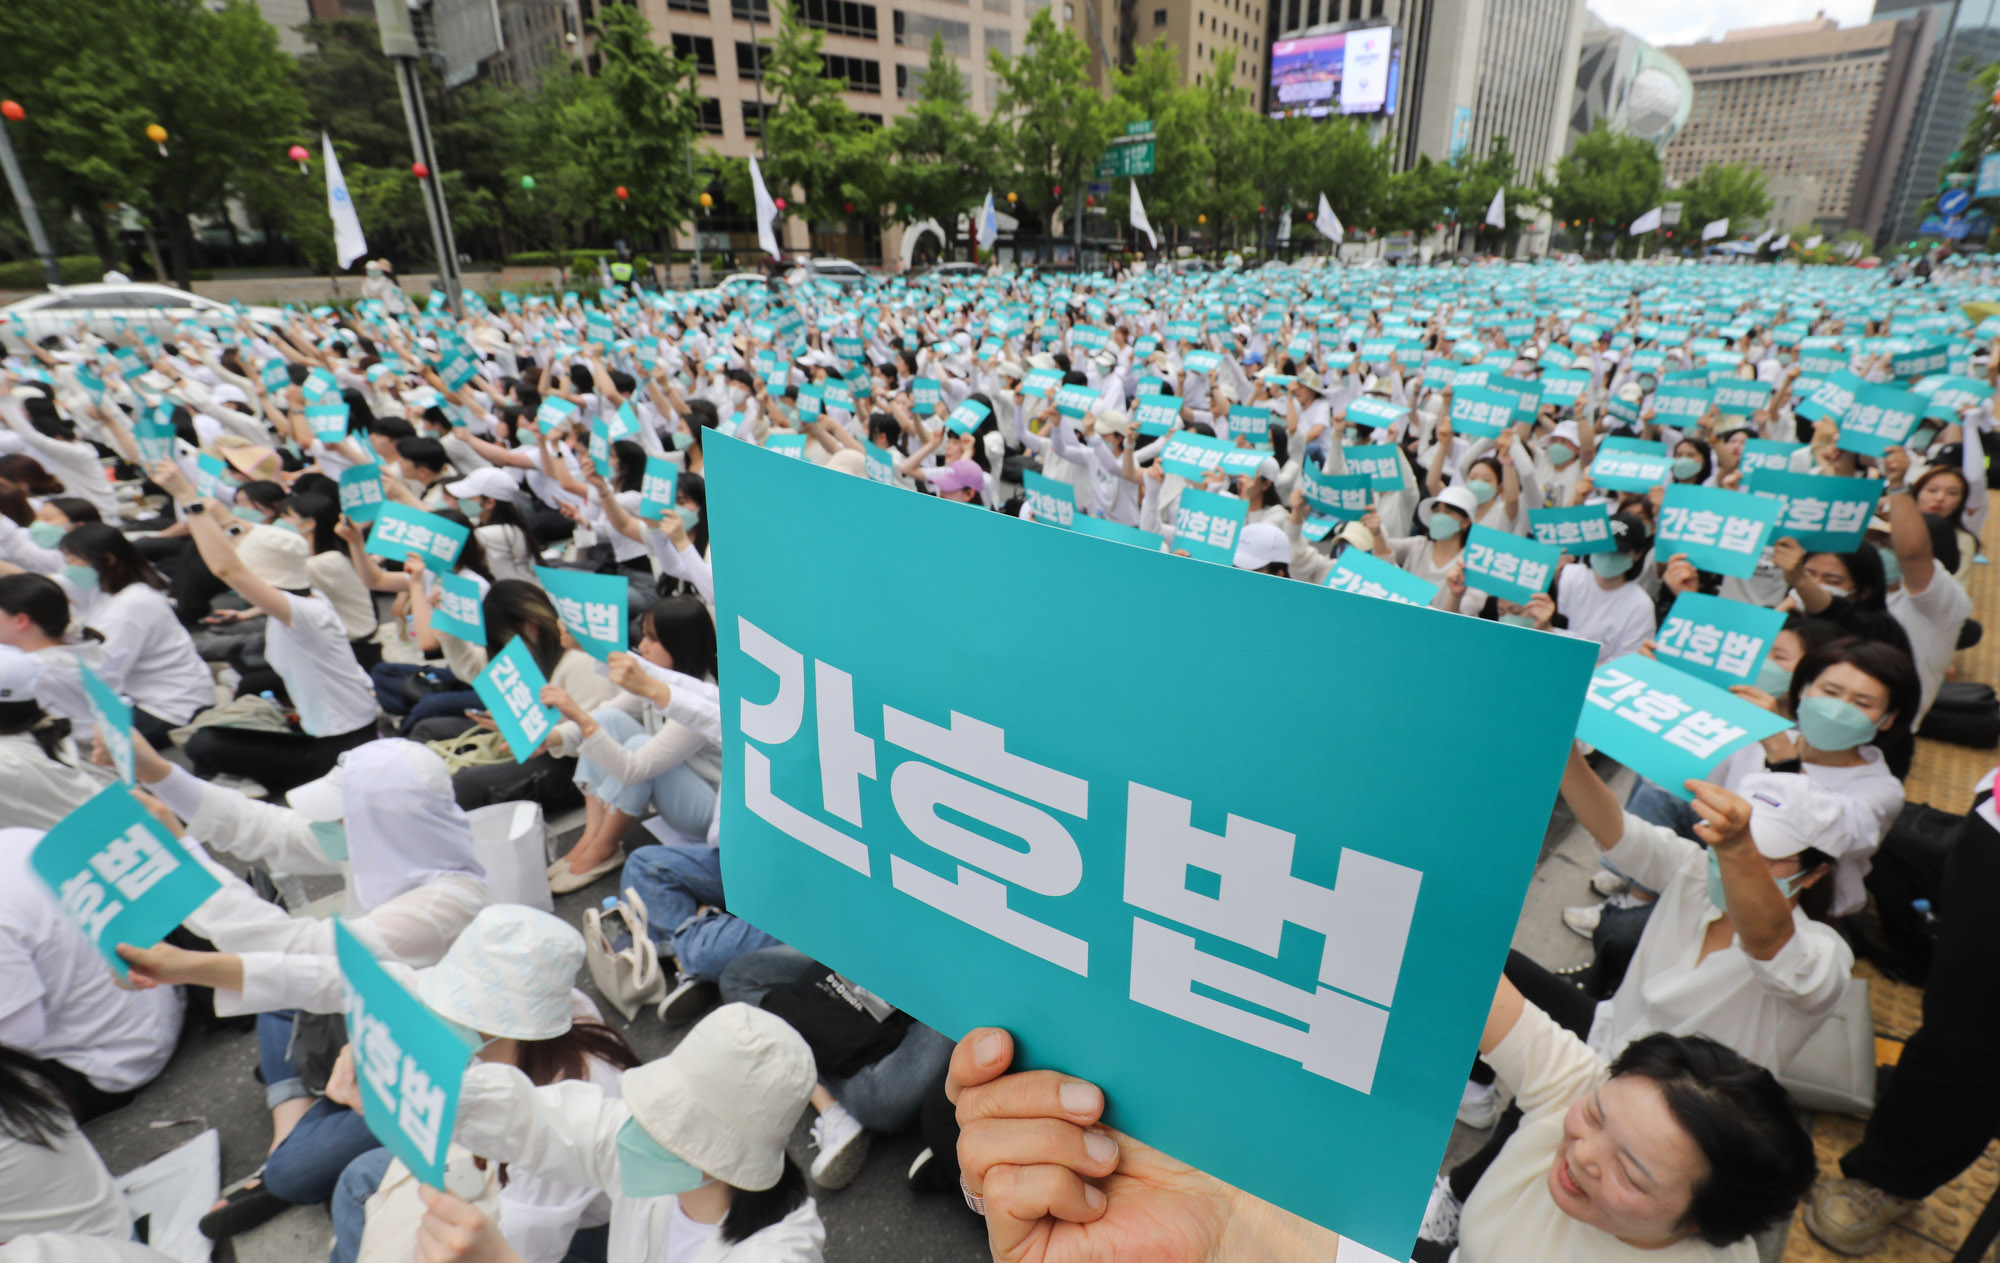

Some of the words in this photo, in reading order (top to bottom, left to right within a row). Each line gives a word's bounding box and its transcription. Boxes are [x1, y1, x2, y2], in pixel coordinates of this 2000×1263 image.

[1137, 404, 1178, 426] 간호법
[1452, 398, 1513, 428] 간호법
[1655, 395, 1708, 417] 간호법
[1714, 387, 1767, 408] 간호법
[1810, 381, 1856, 416] 간호
[1163, 441, 1225, 471] 간호법
[1594, 459, 1666, 480] 간호법
[1026, 488, 1075, 526] 간호법
[1302, 473, 1367, 511] 간호법
[376, 516, 460, 562] 간호법
[1534, 515, 1609, 544] 간호법
[1659, 507, 1765, 554] 간호법
[1466, 543, 1549, 591] 간호법
[1656, 616, 1764, 678] 간호법
[489, 655, 549, 744] 간호법
[1586, 668, 1749, 760] 간호법
[738, 617, 1422, 1095] 간호법
